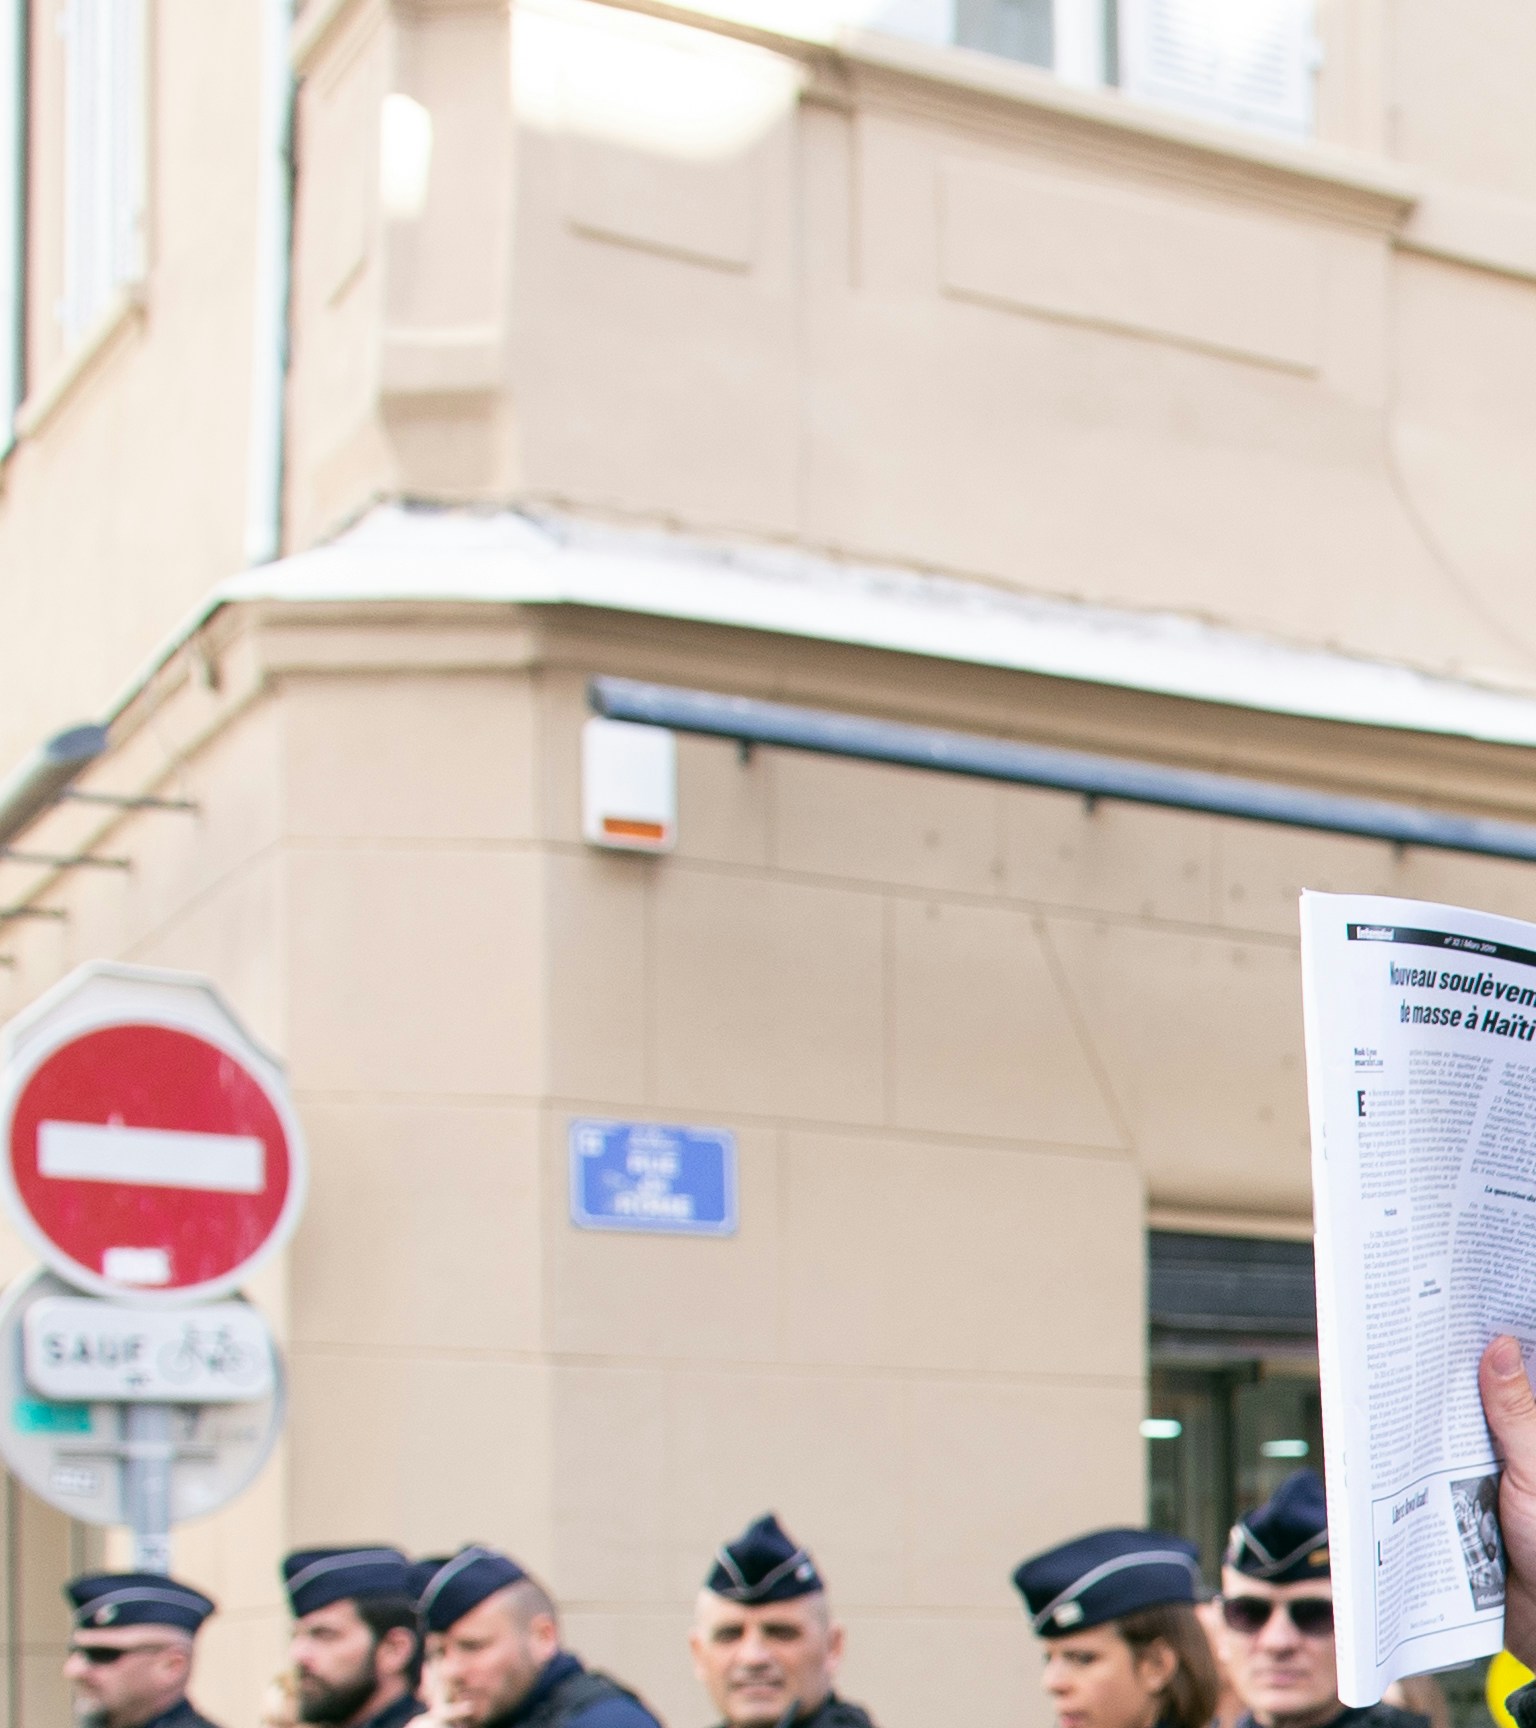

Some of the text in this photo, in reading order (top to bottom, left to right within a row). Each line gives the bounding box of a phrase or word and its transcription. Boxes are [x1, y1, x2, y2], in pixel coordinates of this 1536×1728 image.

[1390, 960, 1437, 988] Nouveau
[1400, 998, 1410, 1023] de
[1412, 1005, 1462, 1028] masse
[1464, 1005, 1479, 1030] à
[1493, 1189, 1526, 1201] question
[1526, 1193, 1536, 1203] du
[43, 1333, 145, 1368] SAUF
